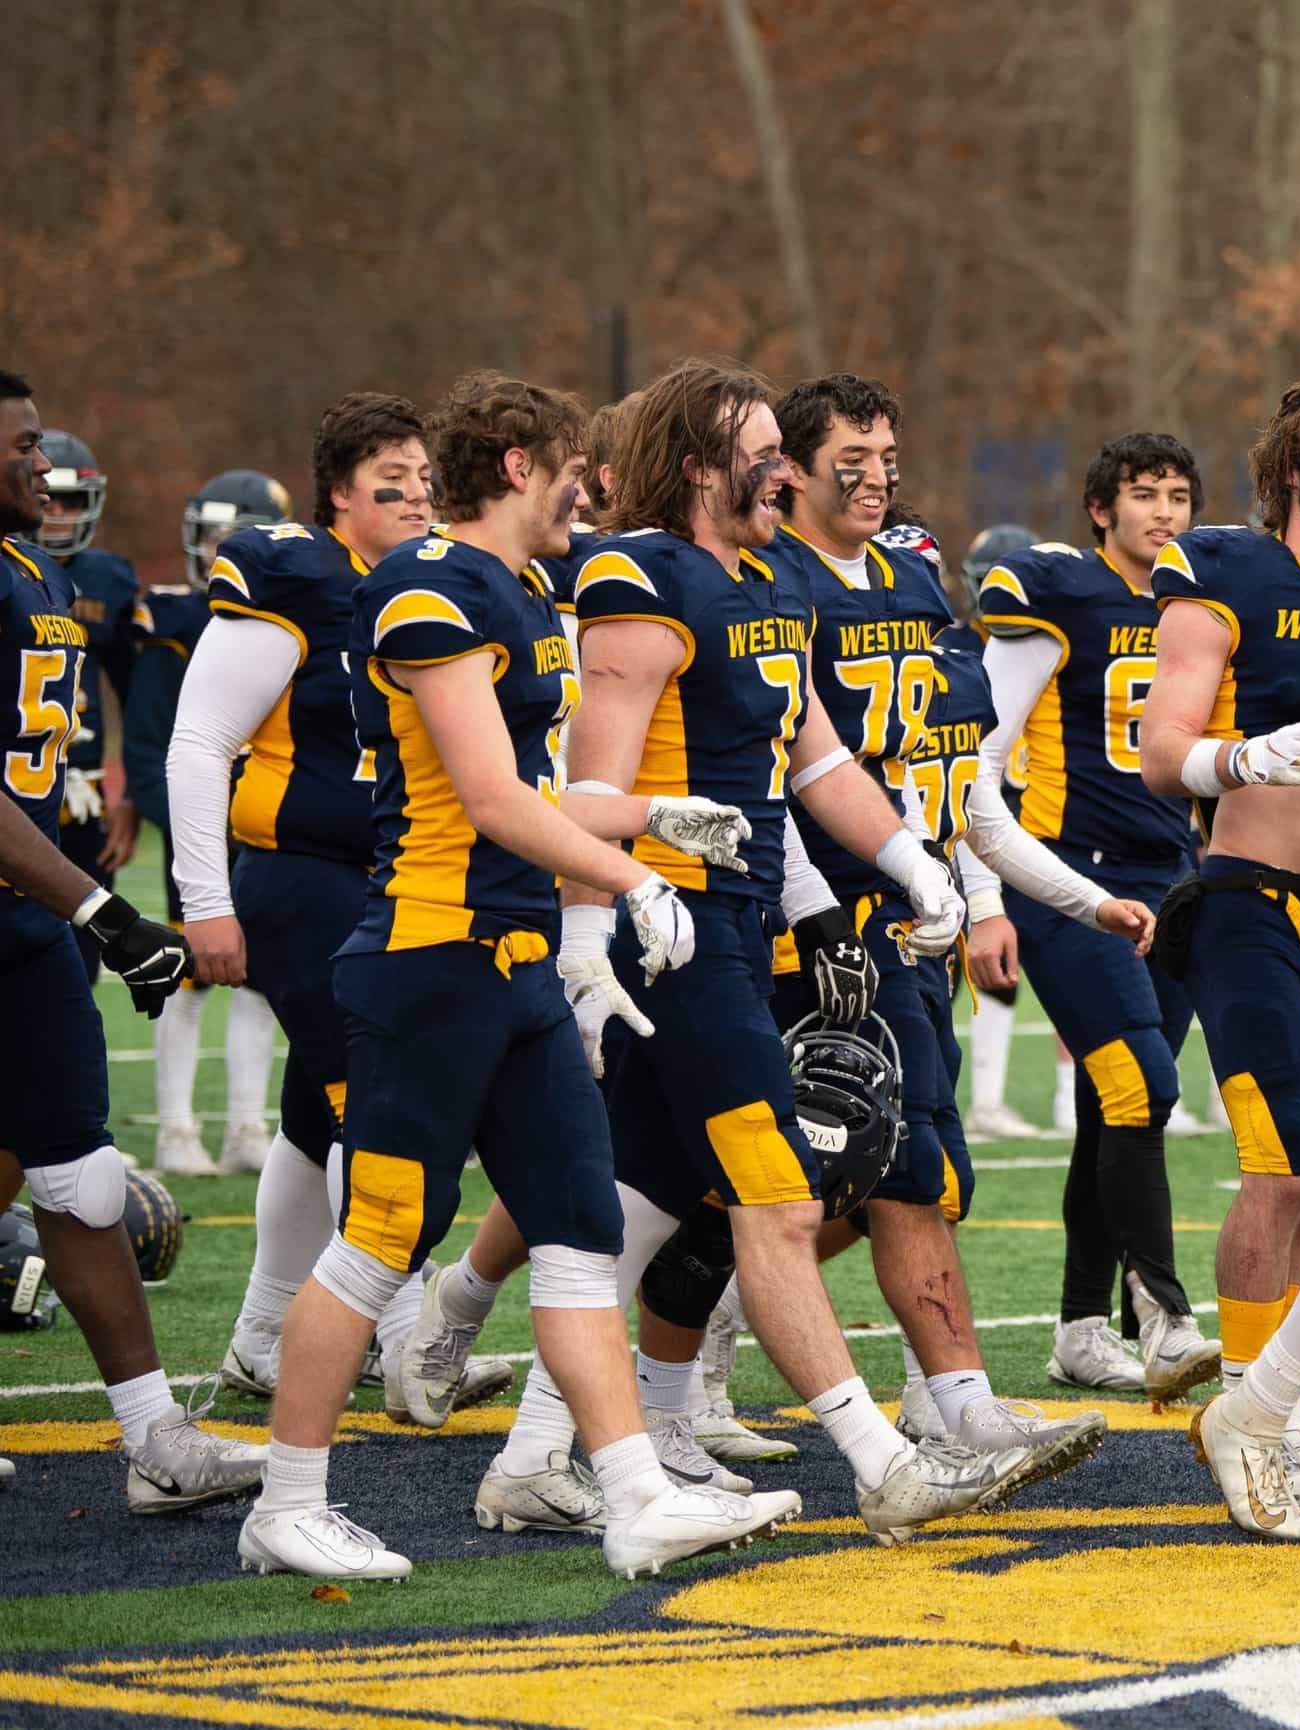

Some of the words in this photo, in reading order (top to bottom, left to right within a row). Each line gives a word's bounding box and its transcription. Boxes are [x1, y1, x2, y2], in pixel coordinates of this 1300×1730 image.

[533, 635, 574, 675] WESTO
[727, 617, 806, 658] WESTON
[839, 620, 932, 656] WESTON
[1109, 626, 1158, 655] WES
[4, 649, 86, 800] 5
[755, 653, 802, 800] 7
[833, 655, 937, 789] 78
[912, 722, 981, 760] STON
[807, 1130, 836, 1147] VIC
